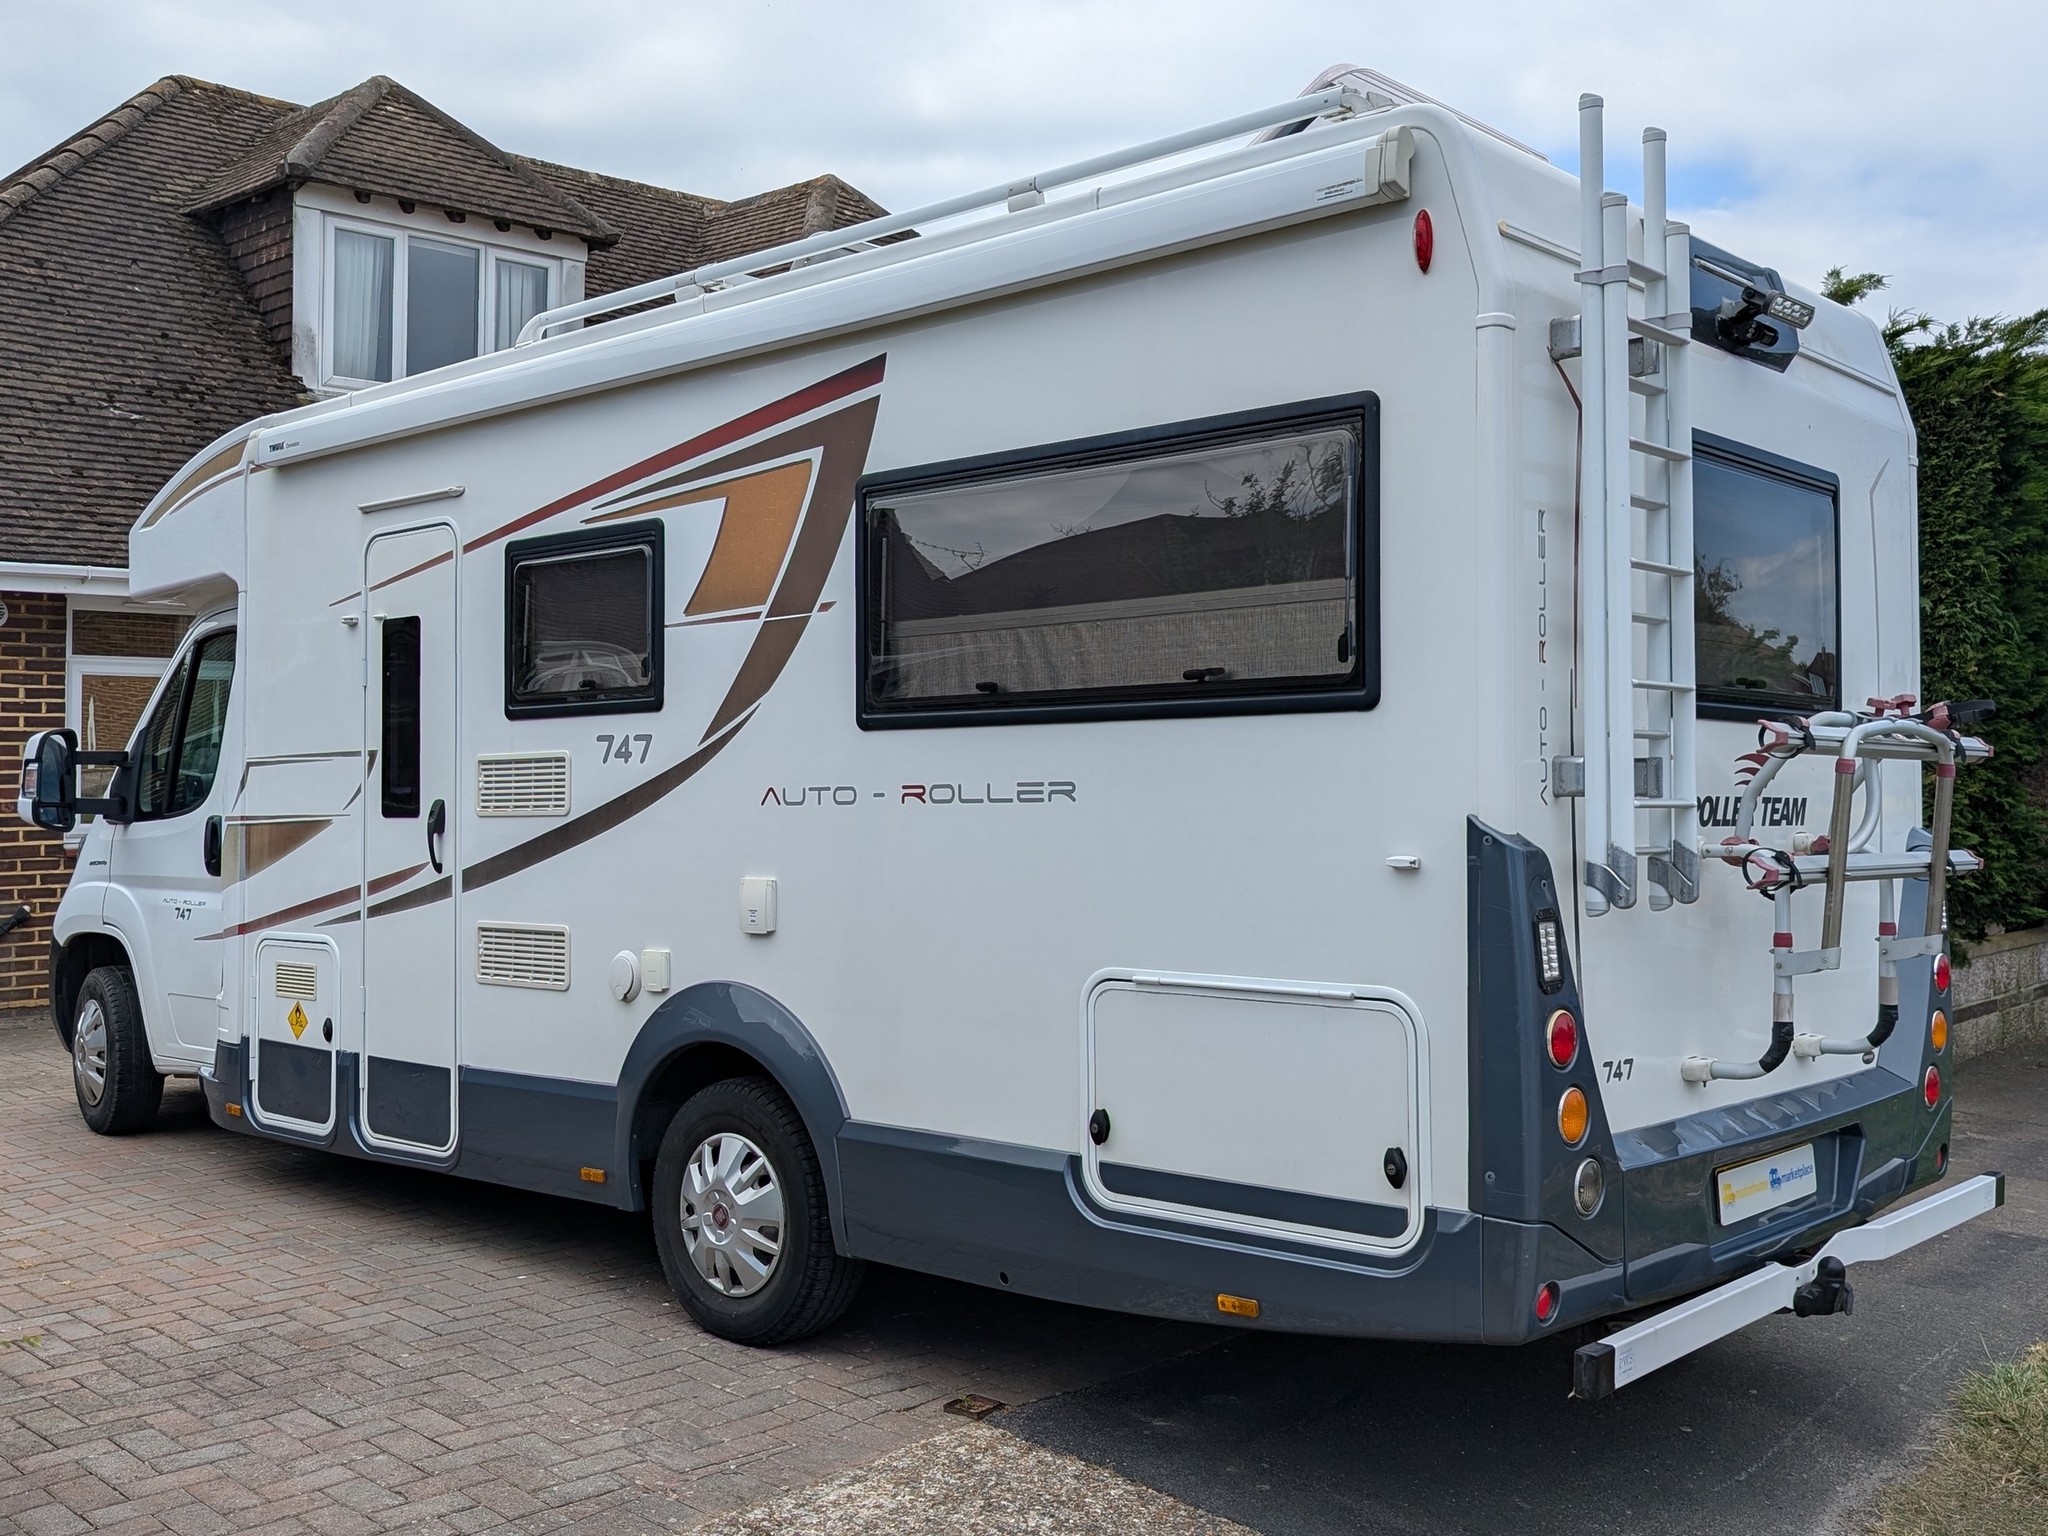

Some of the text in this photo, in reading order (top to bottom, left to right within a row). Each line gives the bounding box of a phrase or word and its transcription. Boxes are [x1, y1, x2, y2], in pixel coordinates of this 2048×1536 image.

[1538, 509, 1547, 664] ROLLER
[596, 733, 653, 765] 747
[1539, 706, 1548, 806] AUTO
[761, 786, 857, 806] AUTO
[901, 781, 1077, 804] ROLLER
[1697, 795, 1808, 828] OLLE TEAM
[175, 906, 192, 921] 747
[1602, 1057, 1634, 1084] 747
[1781, 1164, 1814, 1183] marketplace
